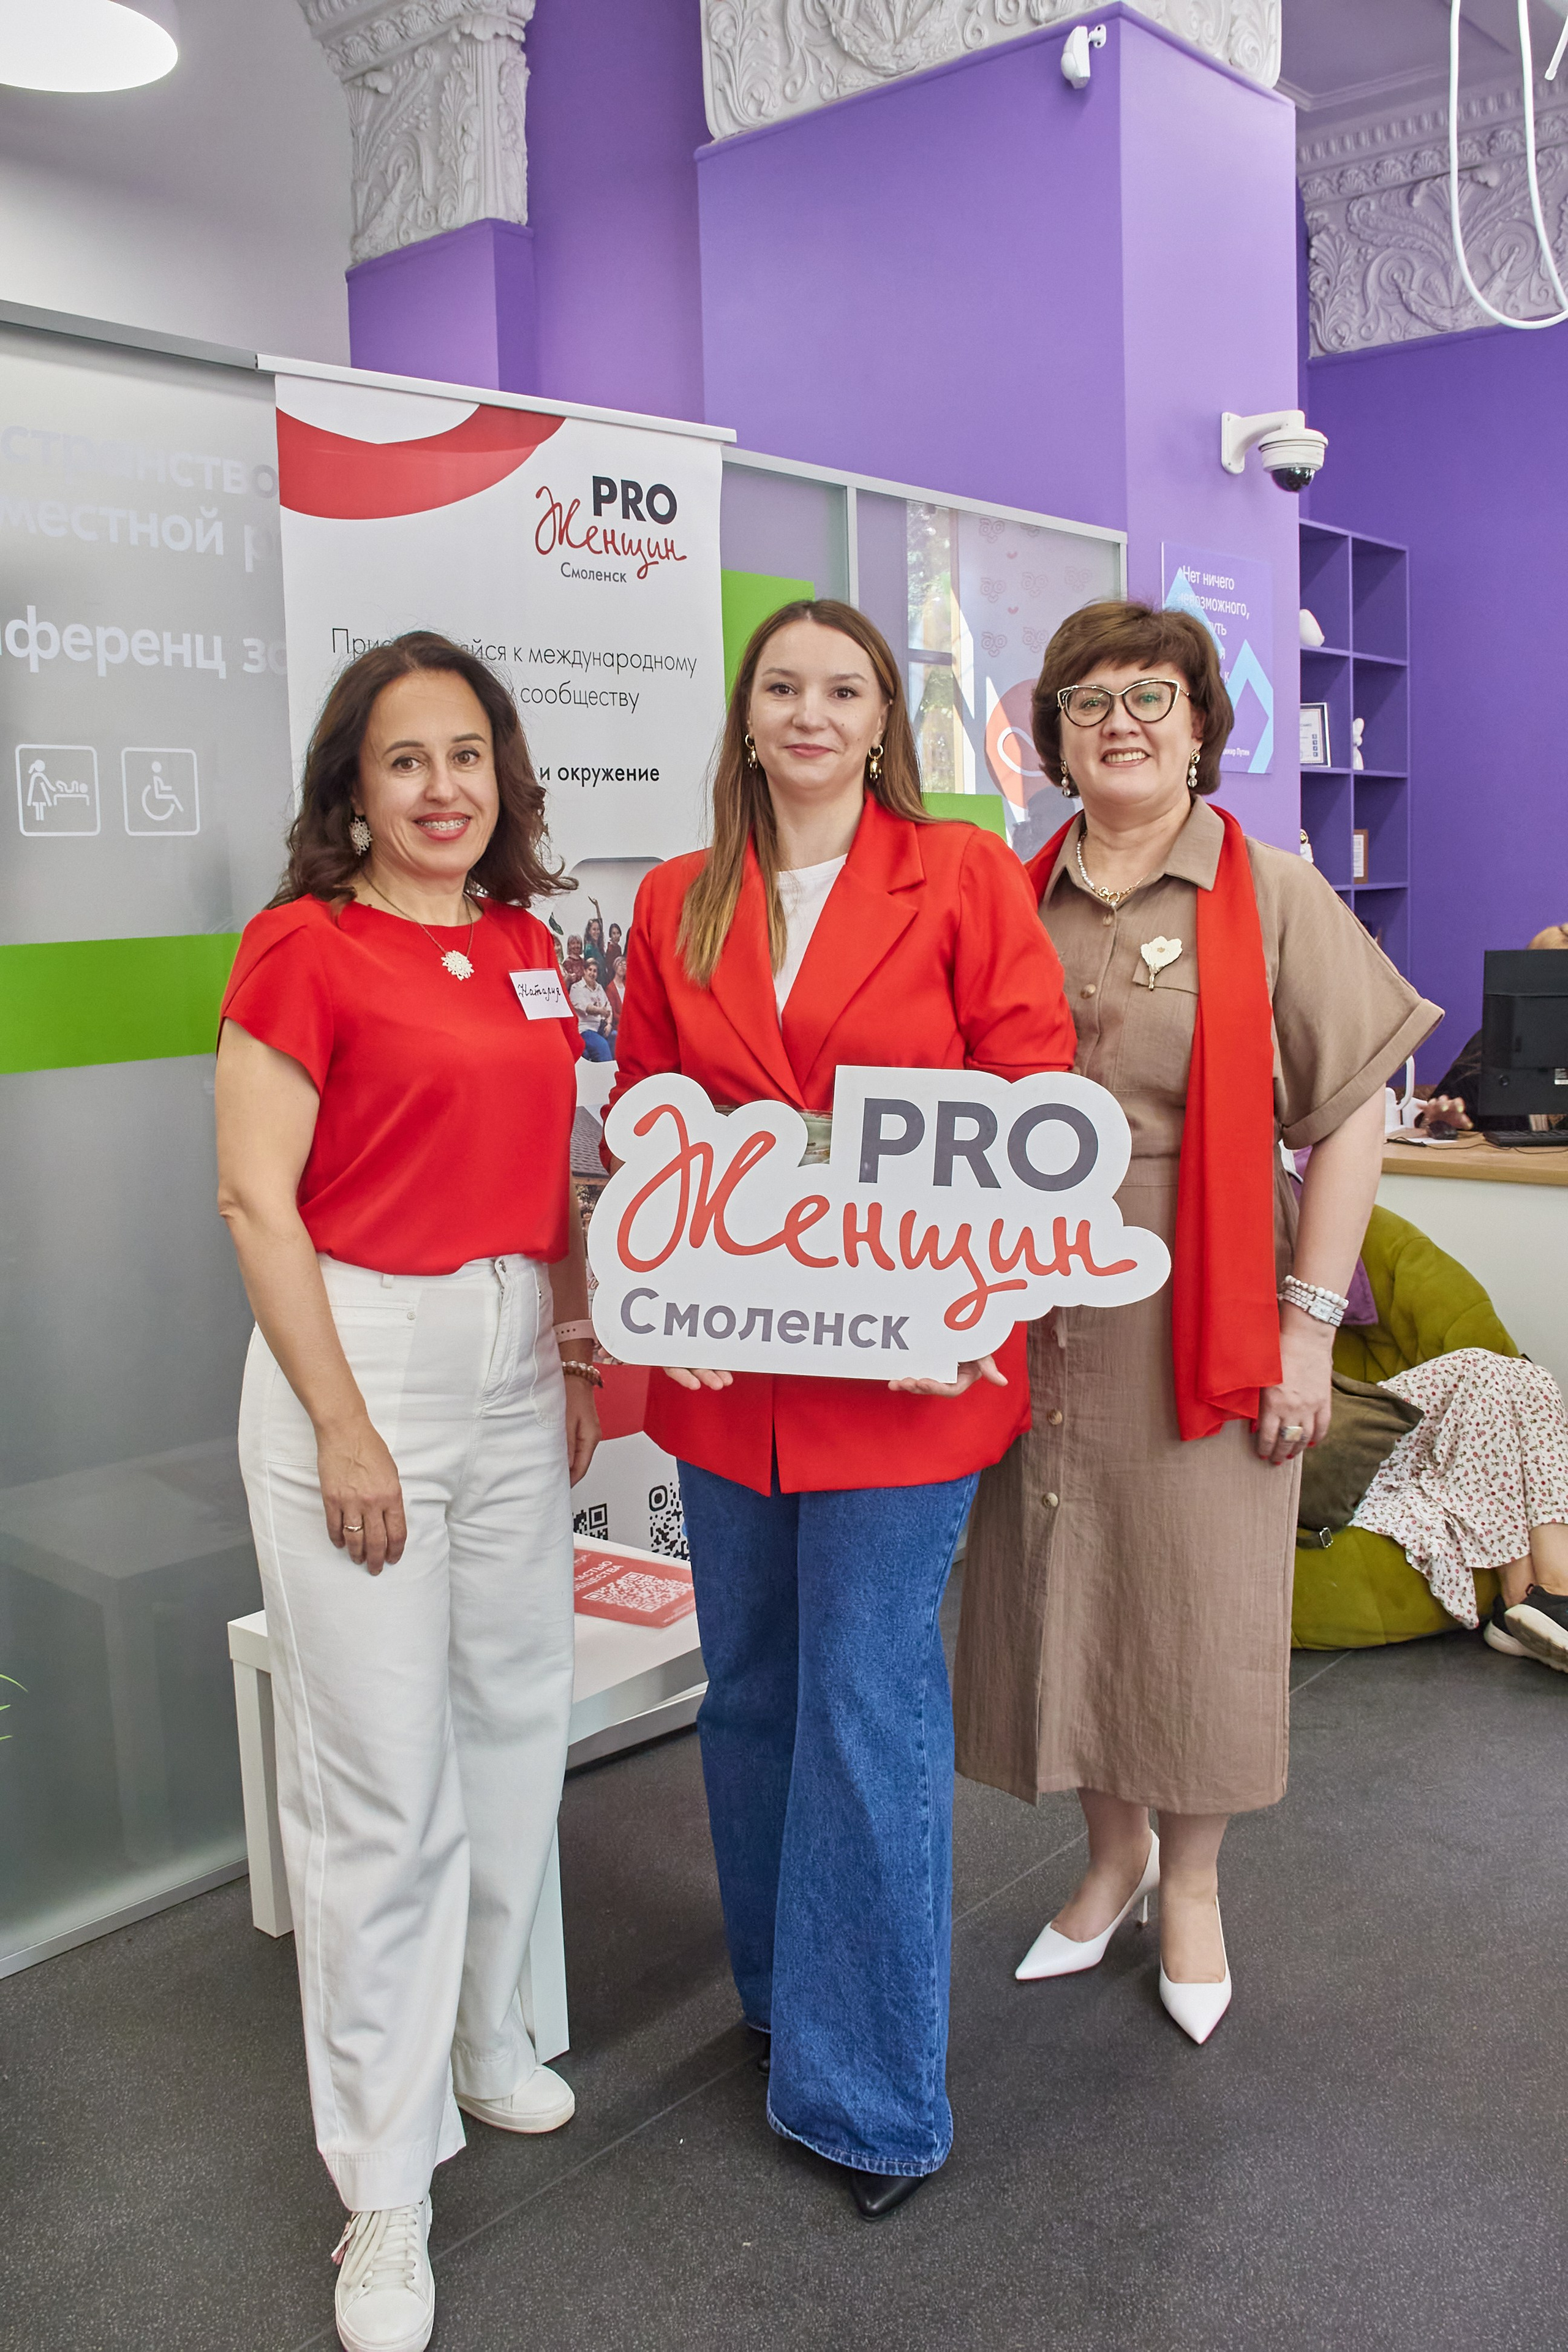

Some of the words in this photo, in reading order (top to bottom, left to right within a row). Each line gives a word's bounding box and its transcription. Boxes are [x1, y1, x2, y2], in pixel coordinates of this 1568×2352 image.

[592, 475, 677, 525] PRO
[535, 486, 687, 579] Женщин
[560, 562, 627, 582] Смоленск
[1203, 573, 1234, 590] ничего
[513, 647, 523, 662] к
[530, 648, 697, 677] международному
[520, 680, 640, 714] сообществу
[540, 766, 550, 781] и
[557, 767, 660, 788] окружение
[858, 1097, 1099, 1192] PRO
[617, 1104, 1139, 1331] Женщин
[620, 1286, 910, 1351] Смоленск
